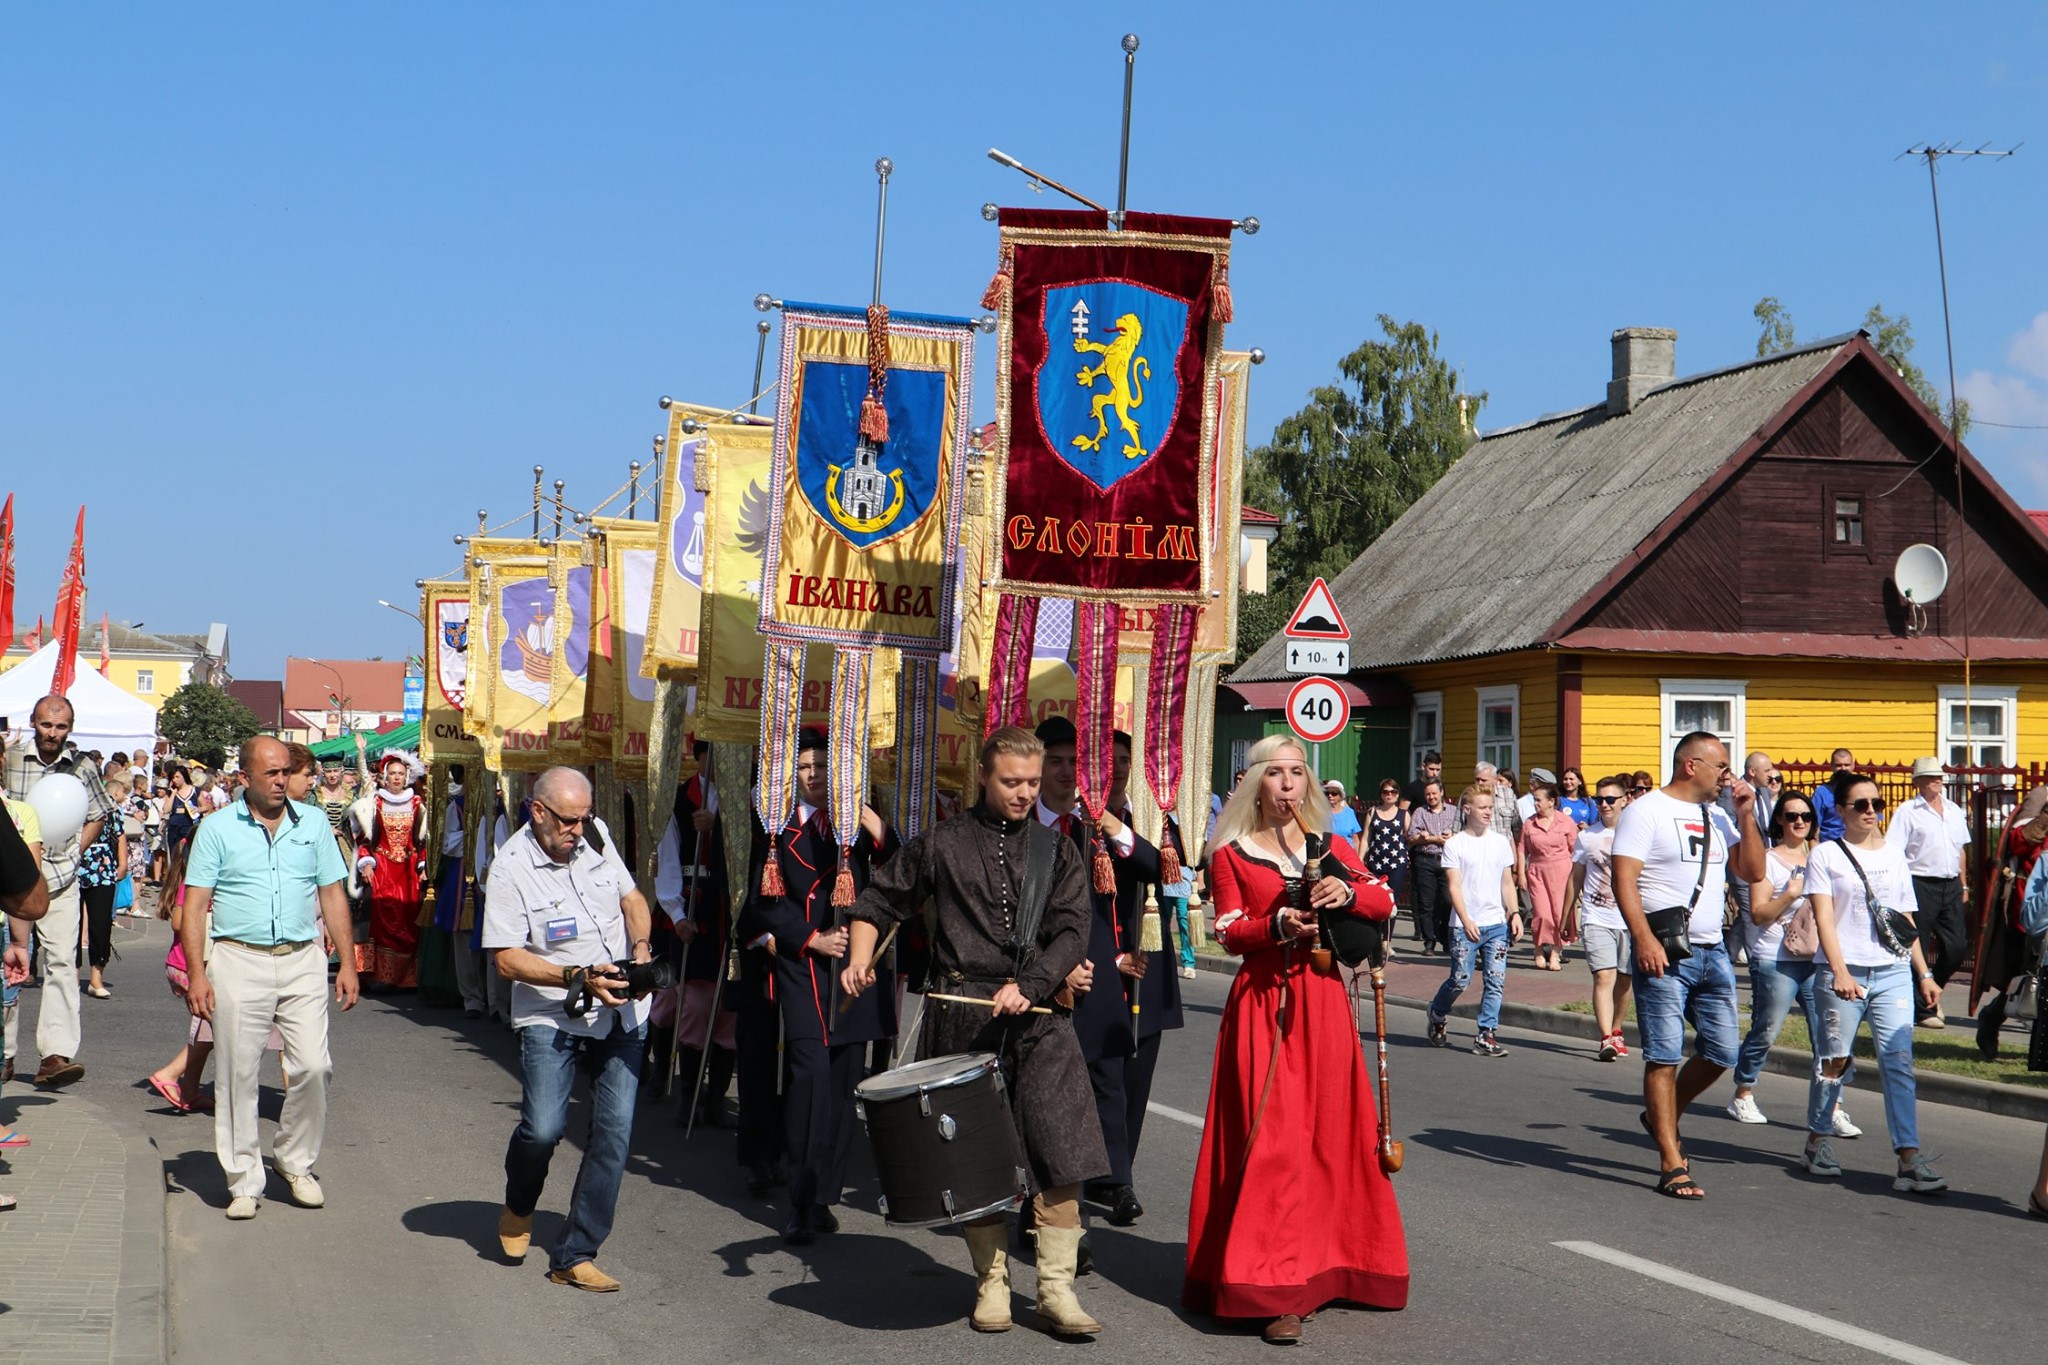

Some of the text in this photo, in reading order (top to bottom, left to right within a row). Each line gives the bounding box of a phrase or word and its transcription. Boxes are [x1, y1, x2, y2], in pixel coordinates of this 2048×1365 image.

[1007, 514, 1198, 561] СЛОНІМ
[786, 568, 936, 618] ІВАНАВА
[1301, 697, 1332, 721] 40
